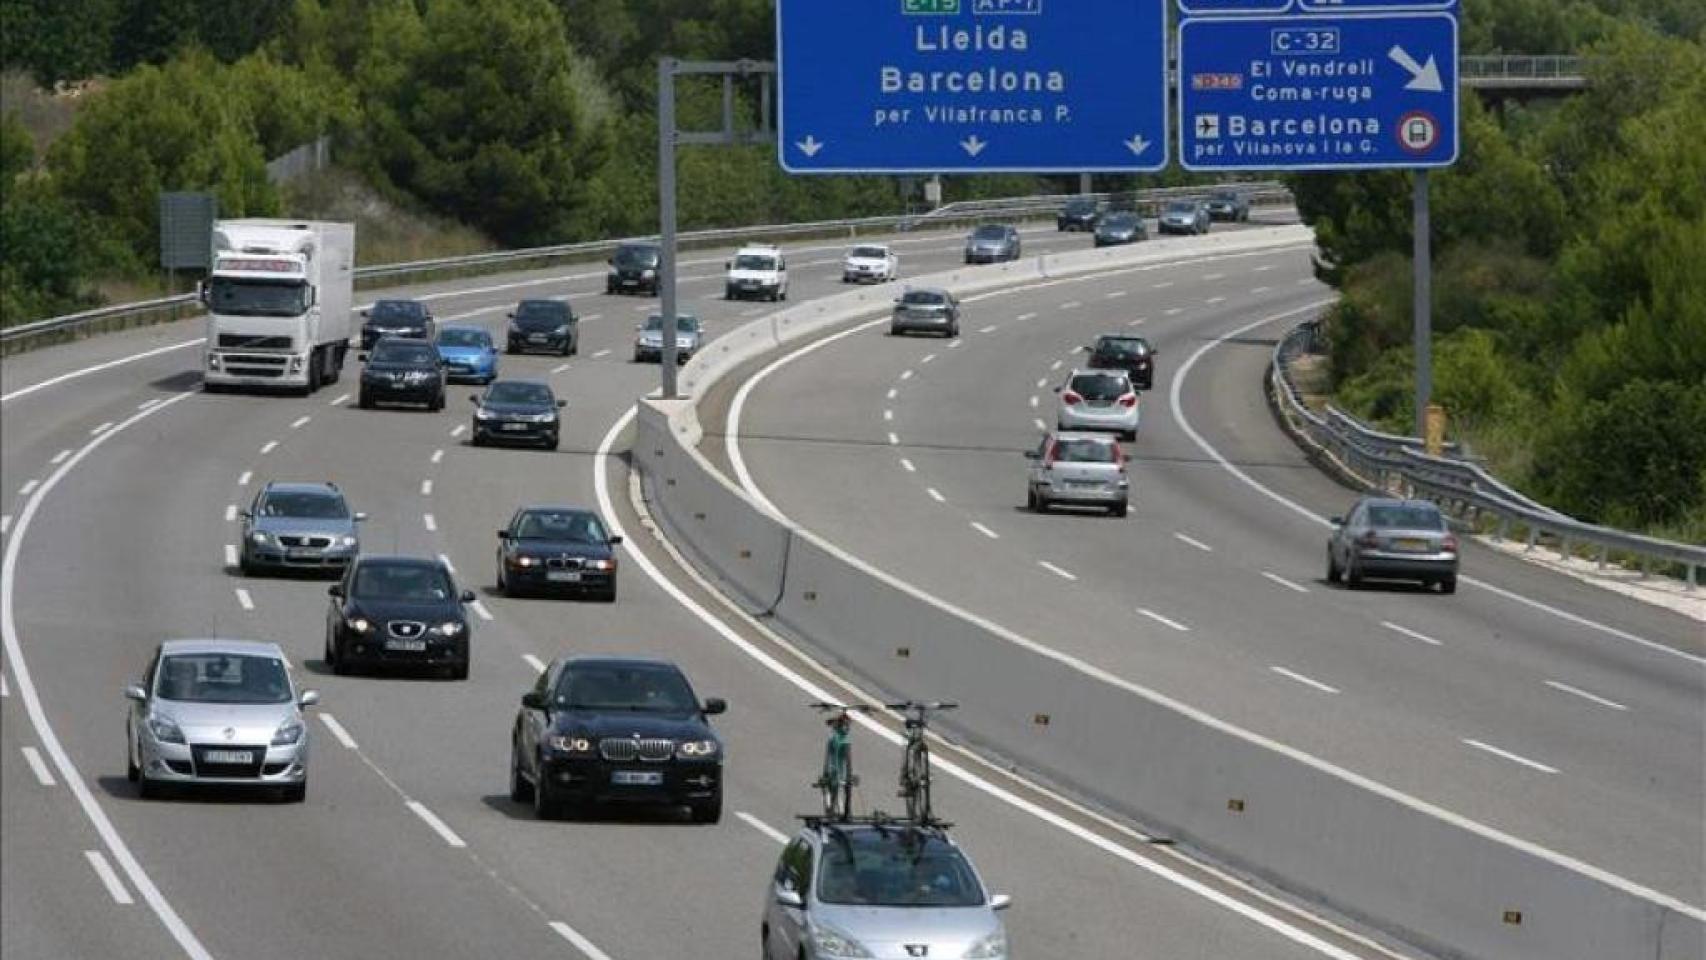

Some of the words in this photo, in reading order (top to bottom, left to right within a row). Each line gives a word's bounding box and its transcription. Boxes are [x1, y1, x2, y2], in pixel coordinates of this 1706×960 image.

[916, 25, 1028, 50] Lleida
[1276, 32, 1334, 50] C-32
[1250, 60, 1271, 77] El
[1282, 59, 1373, 77] Vendrell
[881, 67, 1064, 93] Barcelona
[1250, 84, 1372, 103] Coma-ruga
[875, 109, 911, 126] per
[925, 105, 1042, 123] Vilafranca
[1055, 105, 1072, 123] P.
[1228, 114, 1380, 136] Barcelona
[1194, 143, 1224, 160] per
[1233, 141, 1317, 156] Vilanova
[1335, 140, 1353, 153] la
[1360, 139, 1378, 153] G.
